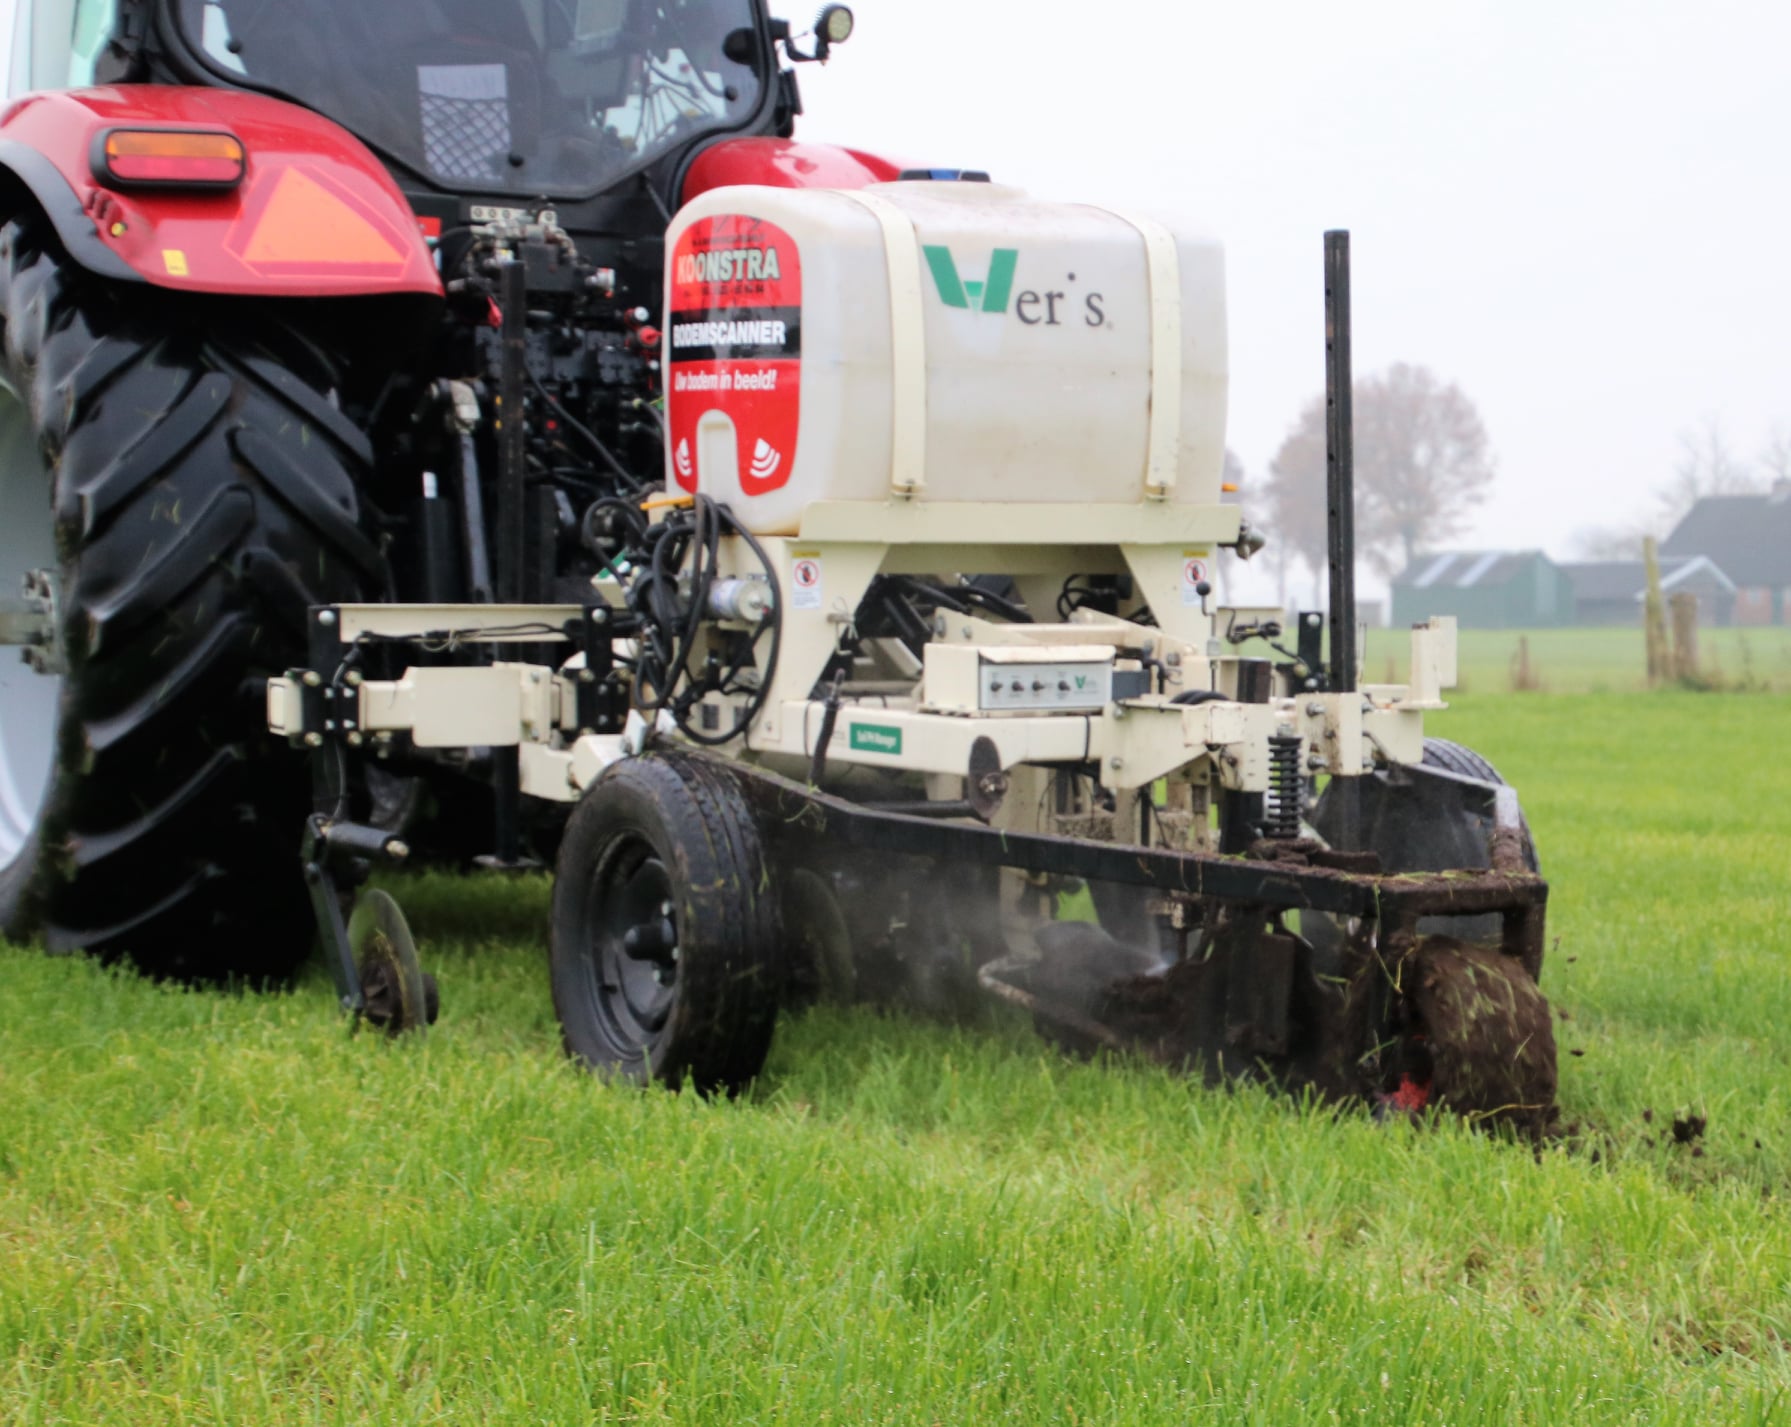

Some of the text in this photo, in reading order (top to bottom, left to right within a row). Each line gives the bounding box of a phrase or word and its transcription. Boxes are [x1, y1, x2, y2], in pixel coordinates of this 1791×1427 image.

[677, 247, 780, 284] KOONSTRA
[673, 320, 786, 348] BODEMSCANNER
[720, 369, 732, 390] in
[734, 369, 778, 390] beeld!
